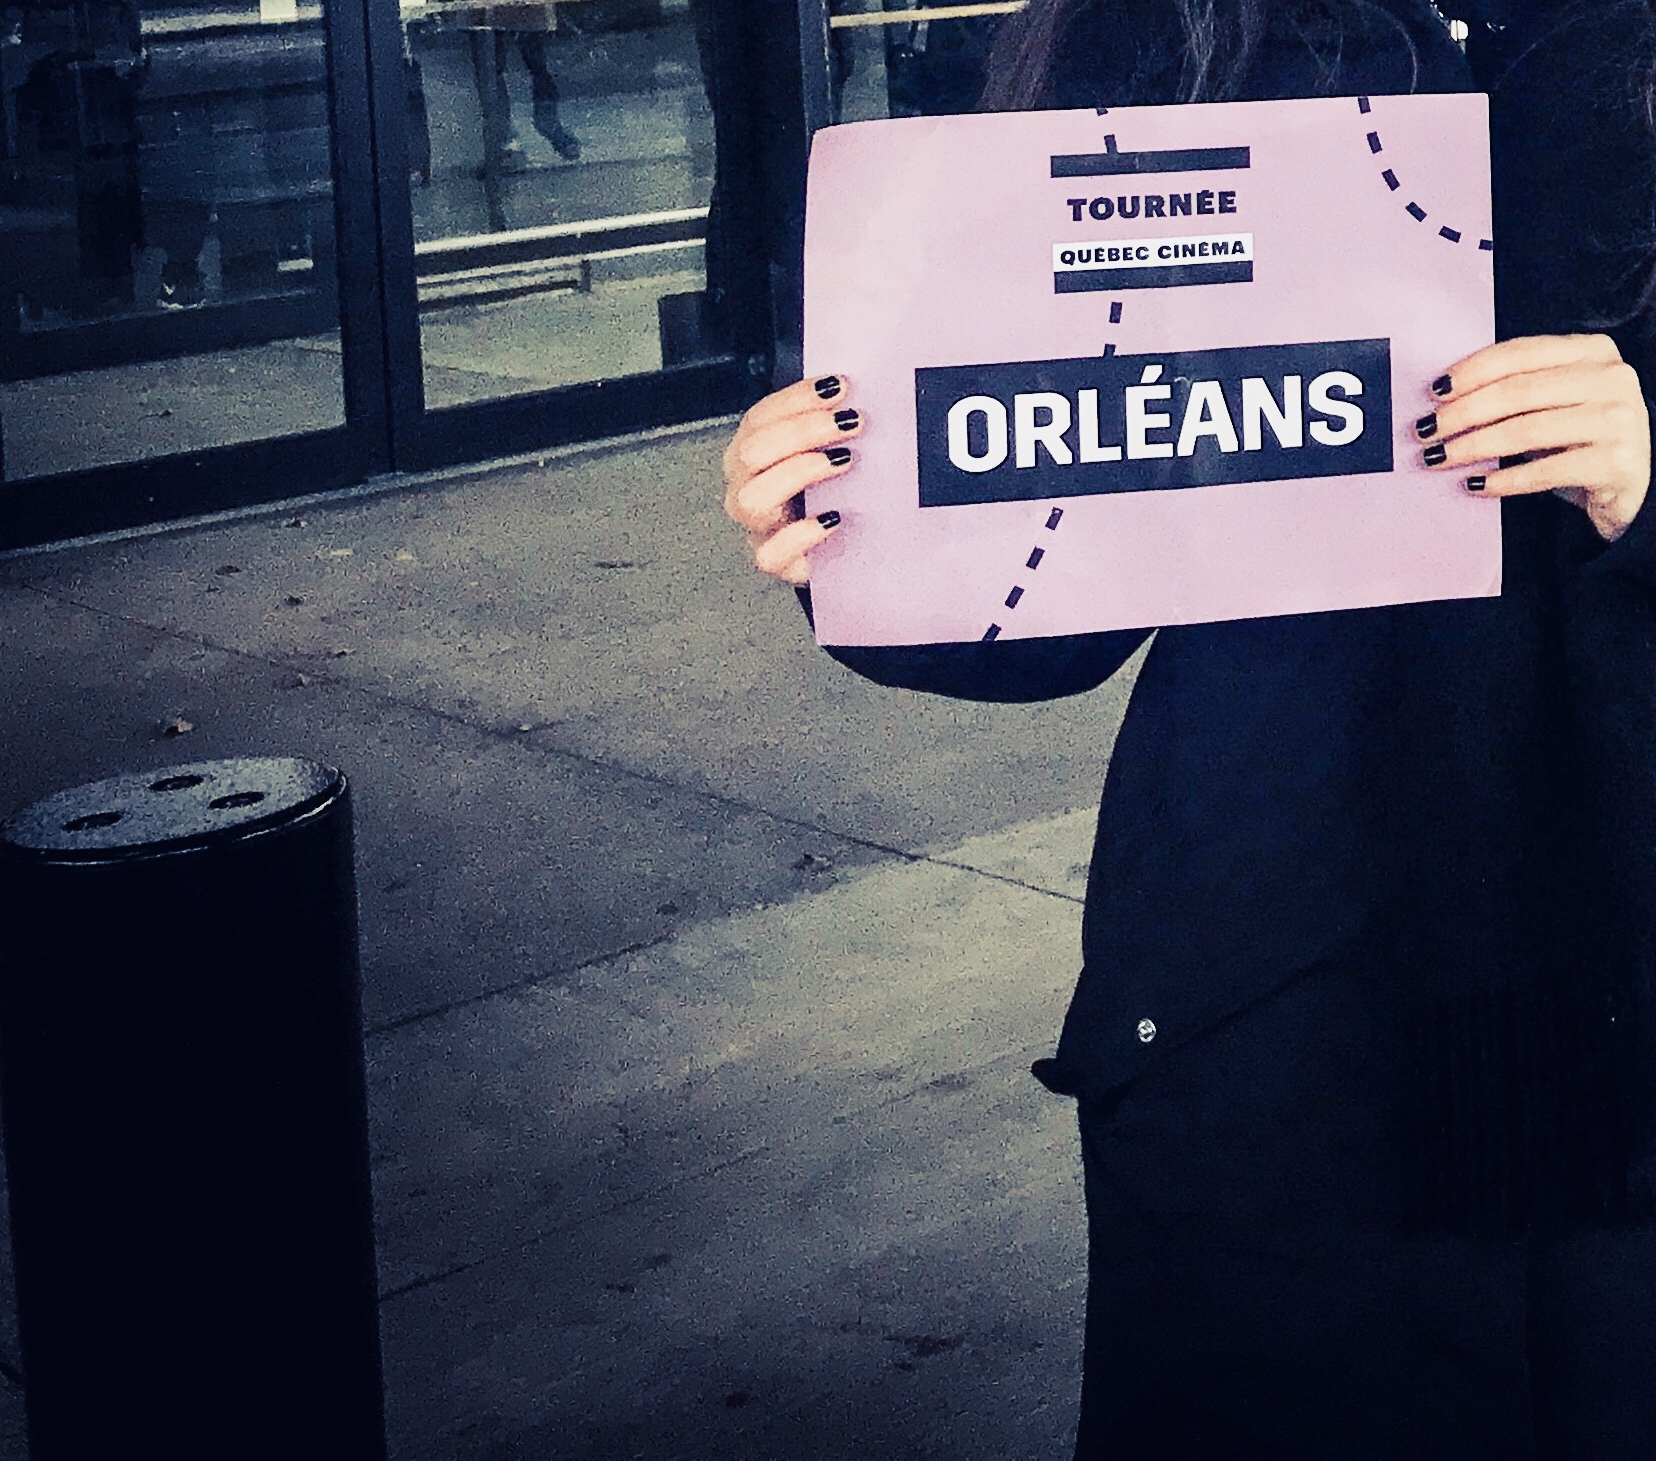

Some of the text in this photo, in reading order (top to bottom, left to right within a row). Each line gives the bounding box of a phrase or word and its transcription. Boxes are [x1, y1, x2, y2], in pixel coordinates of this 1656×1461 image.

[1066, 189, 1237, 222] TOURNÉE
[1060, 240, 1245, 266] QUÉBEC CINÉMA
[947, 364, 1364, 473] ORLÉANS
